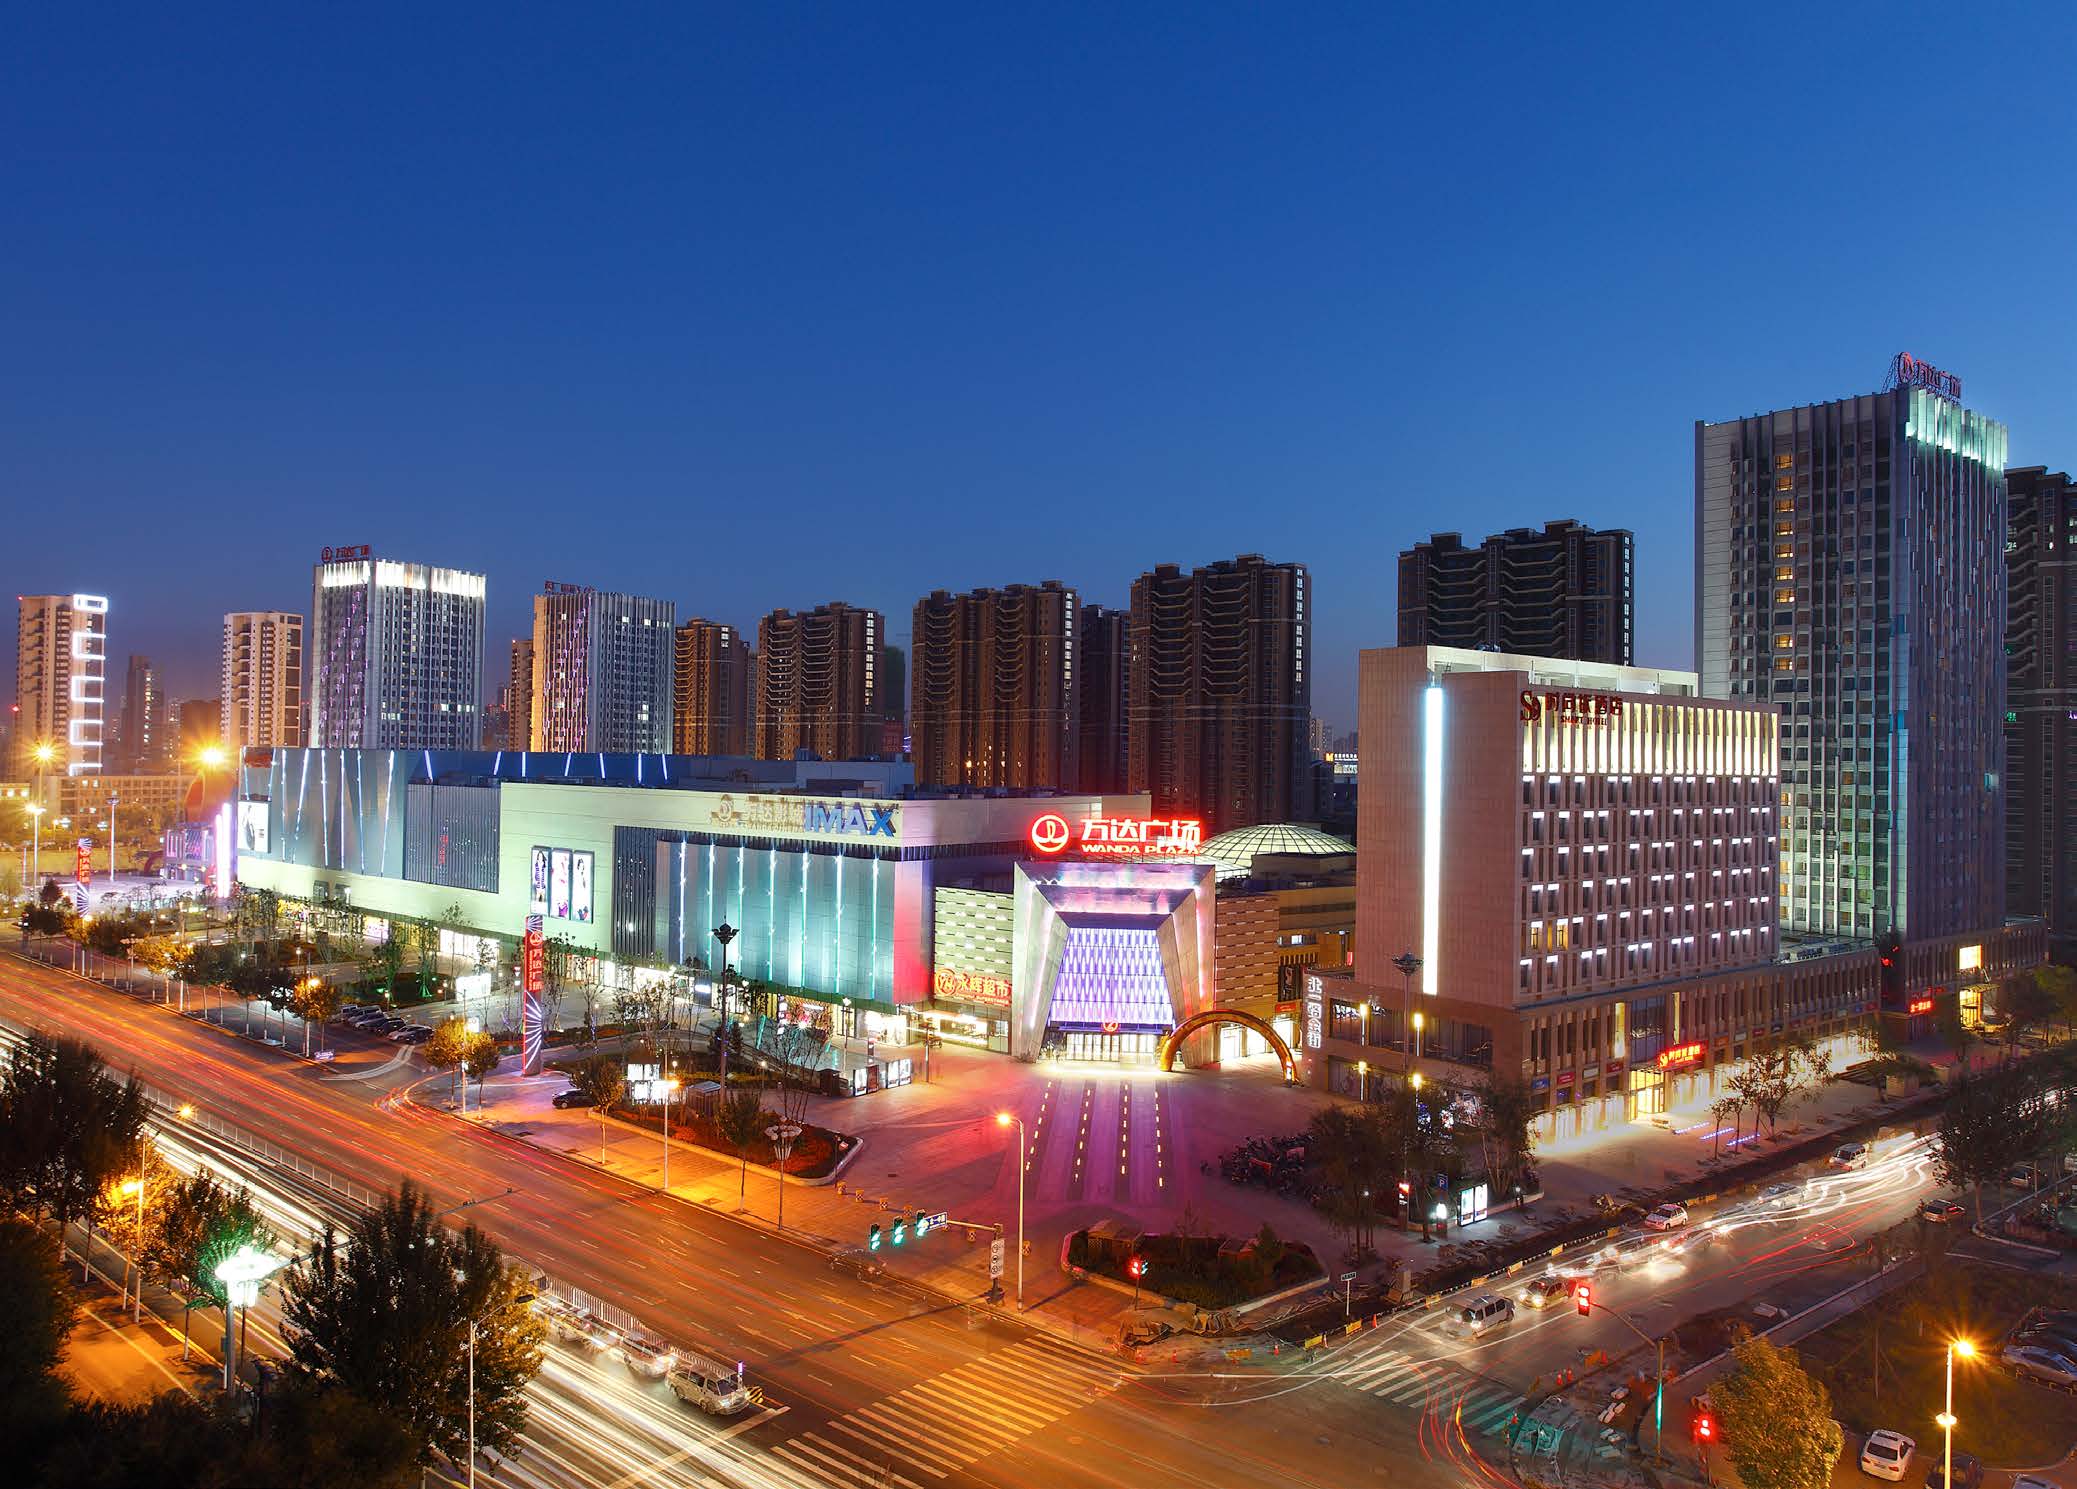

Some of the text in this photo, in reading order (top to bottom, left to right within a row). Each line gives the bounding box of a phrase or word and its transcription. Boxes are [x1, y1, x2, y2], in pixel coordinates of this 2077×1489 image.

[804, 801, 896, 838] IMAX
[1080, 818, 1201, 846] 万达广场
[1081, 842, 1202, 854] WANDA PLAZA
[957, 973, 1009, 997] 永辉超市
